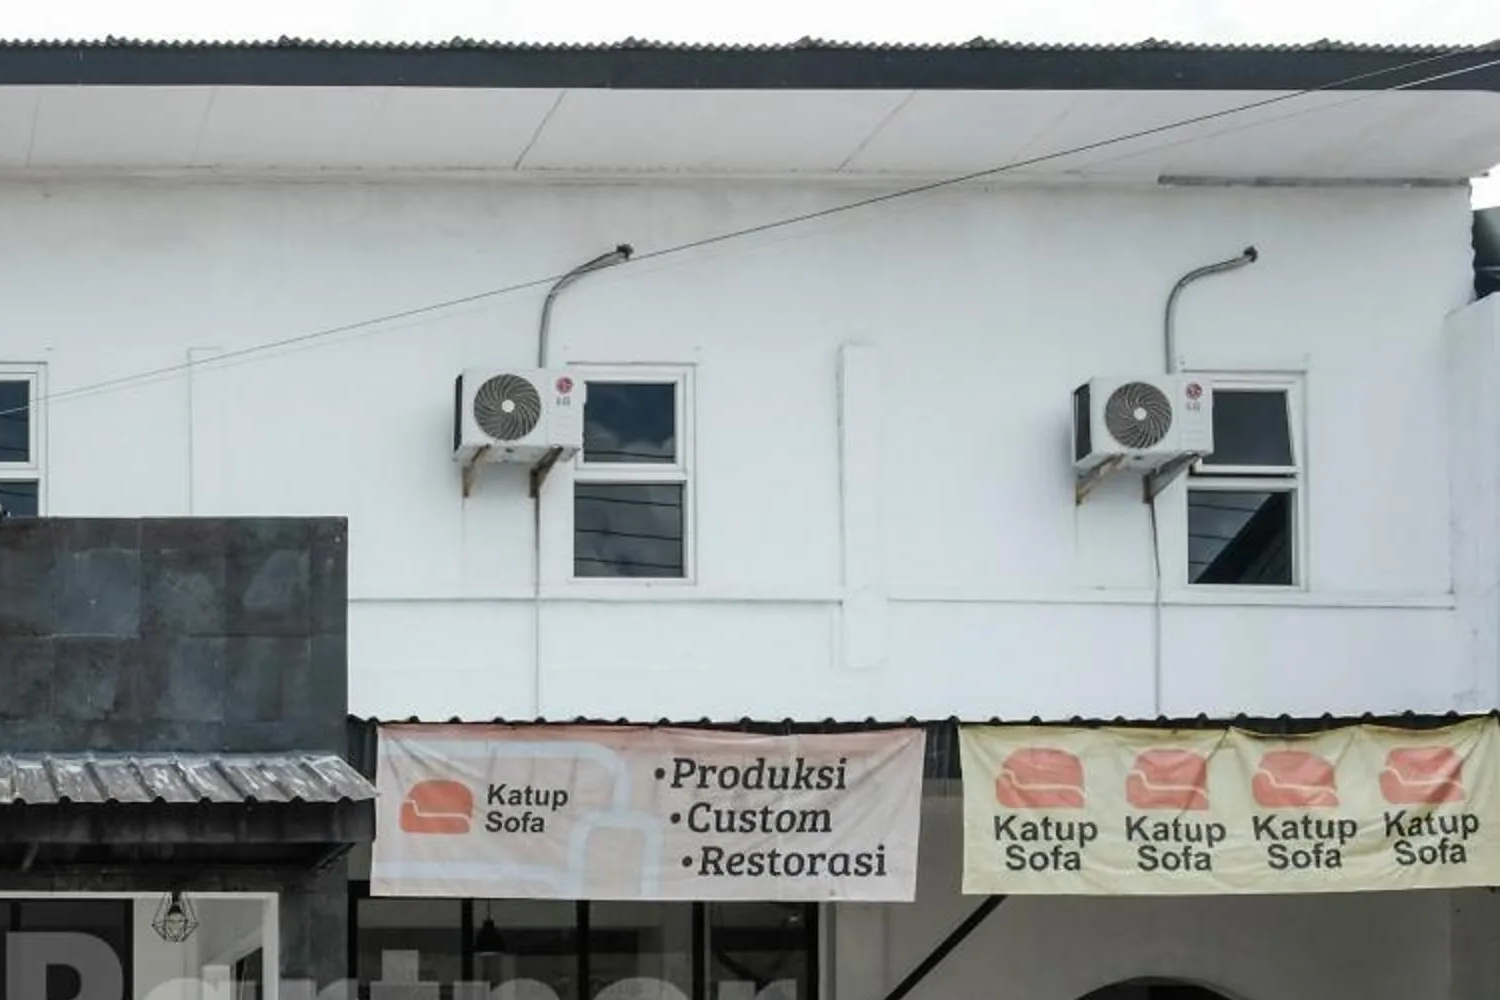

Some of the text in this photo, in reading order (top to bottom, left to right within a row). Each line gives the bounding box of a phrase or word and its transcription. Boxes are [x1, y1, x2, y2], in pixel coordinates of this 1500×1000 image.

[670, 757, 848, 790] Produksi
[487, 783, 569, 812] Katup
[485, 810, 546, 833] Sofa
[687, 802, 833, 834] Custom
[993, 809, 1479, 849] Katup Katup Katup Katup
[698, 844, 888, 876] Restorasi
[1005, 836, 1468, 872] Sofa Sofa Sofa Sofa
